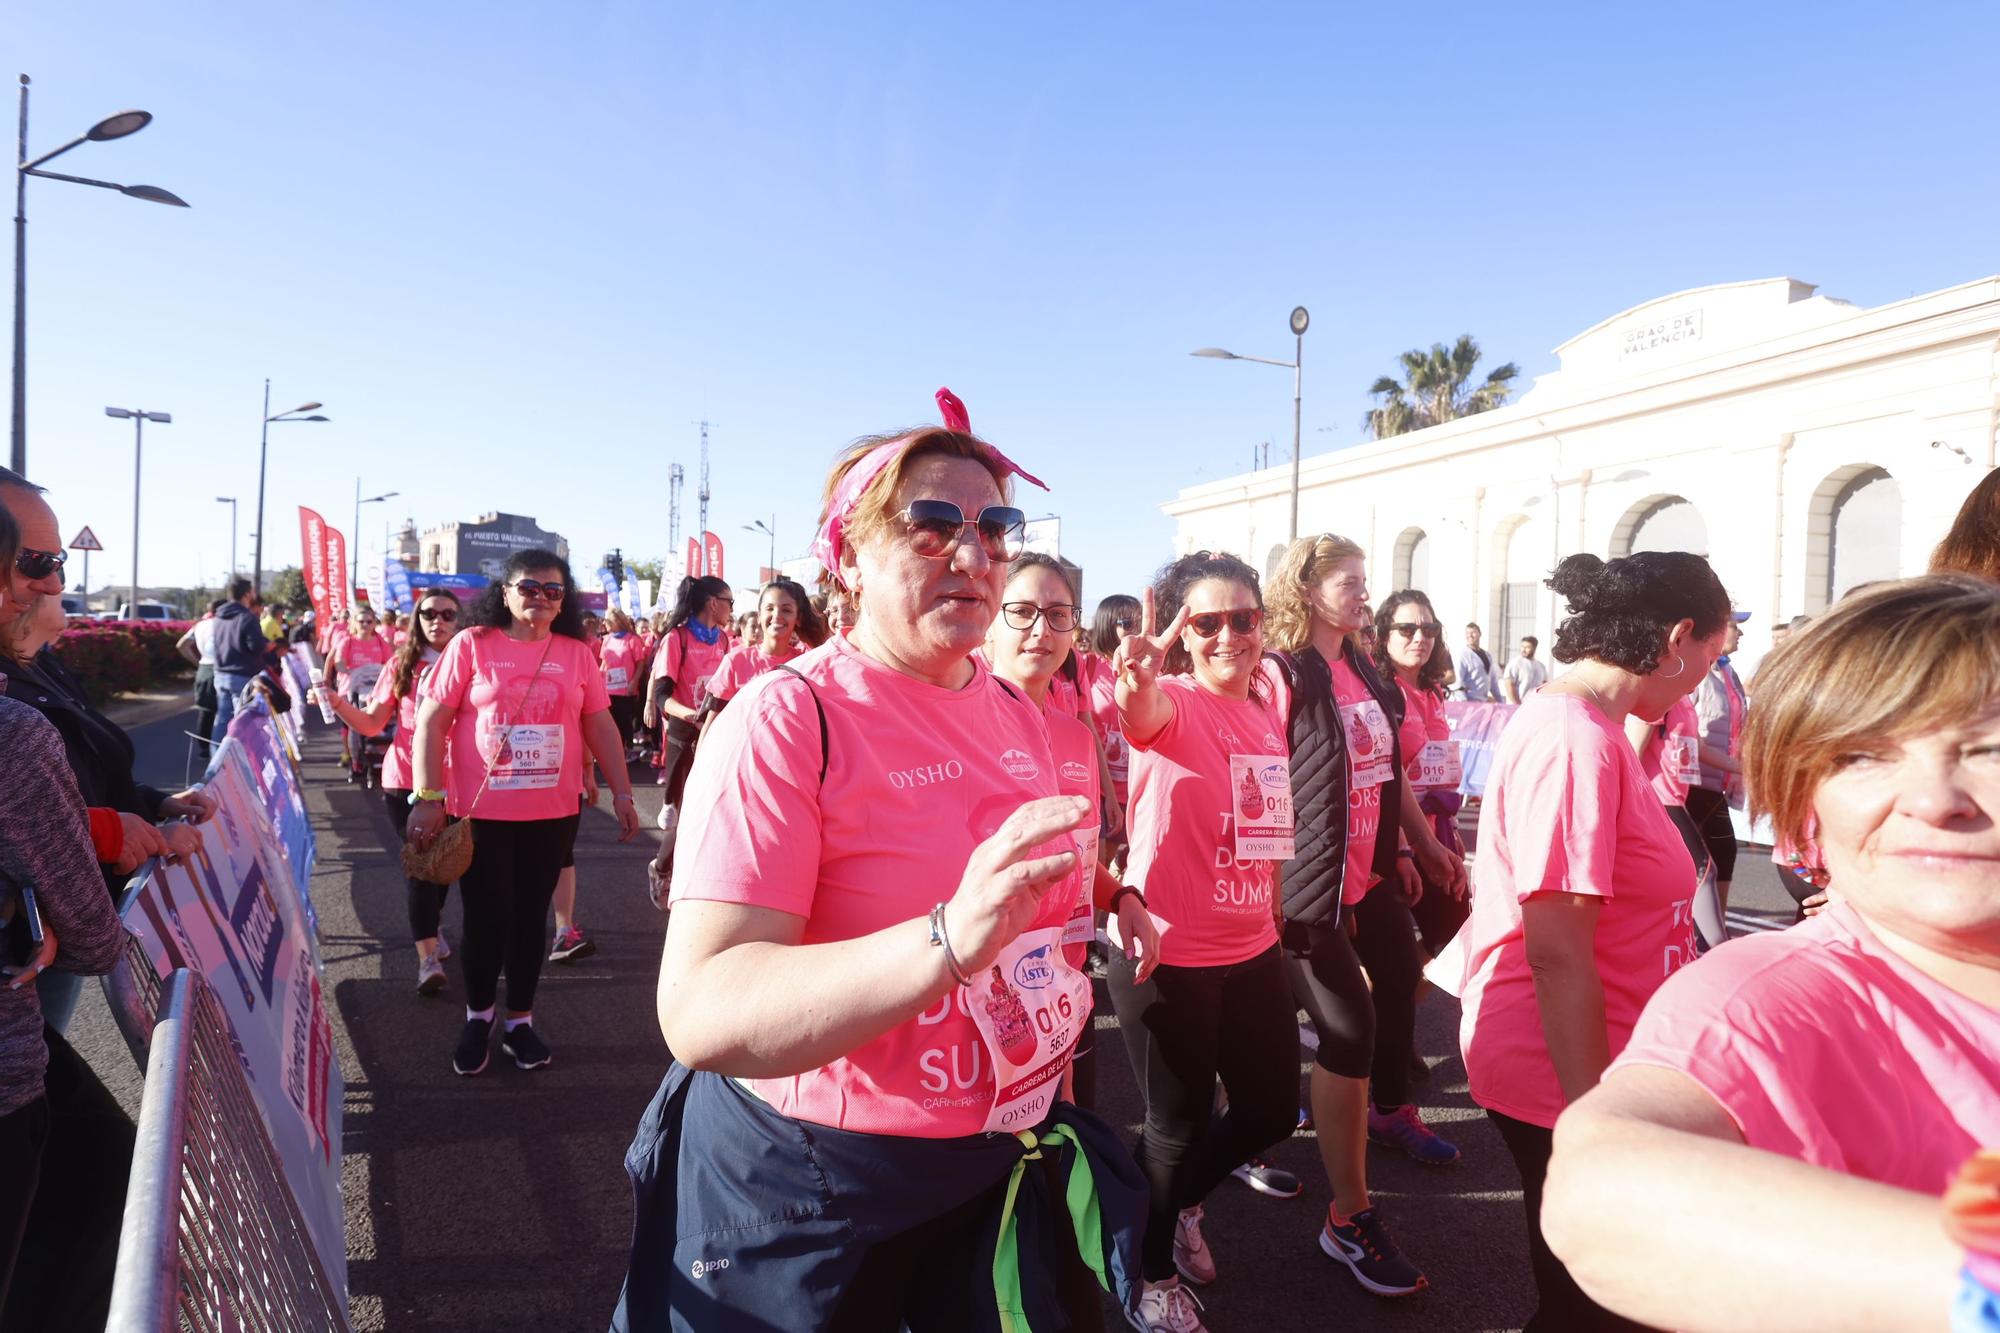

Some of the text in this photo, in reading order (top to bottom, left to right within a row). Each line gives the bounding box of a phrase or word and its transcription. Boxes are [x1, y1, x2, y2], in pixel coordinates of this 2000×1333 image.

[1673, 316, 1694, 330] DE
[1624, 328, 1696, 354] VALENCIA
[473, 532, 500, 542] PUERTO
[514, 750, 540, 760] 016
[888, 759, 964, 790] OYSHO
[1423, 766, 1445, 775] 016
[1266, 796, 1289, 812] 016
[1246, 844, 1275, 852] OYSHO
[1213, 879, 1272, 906] SUMA
[1035, 993, 1072, 1034] 016
[1050, 1028, 1070, 1054] 5637
[1011, 1070, 1047, 1096] CARRERA
[1001, 1095, 1045, 1125] OYSHO
